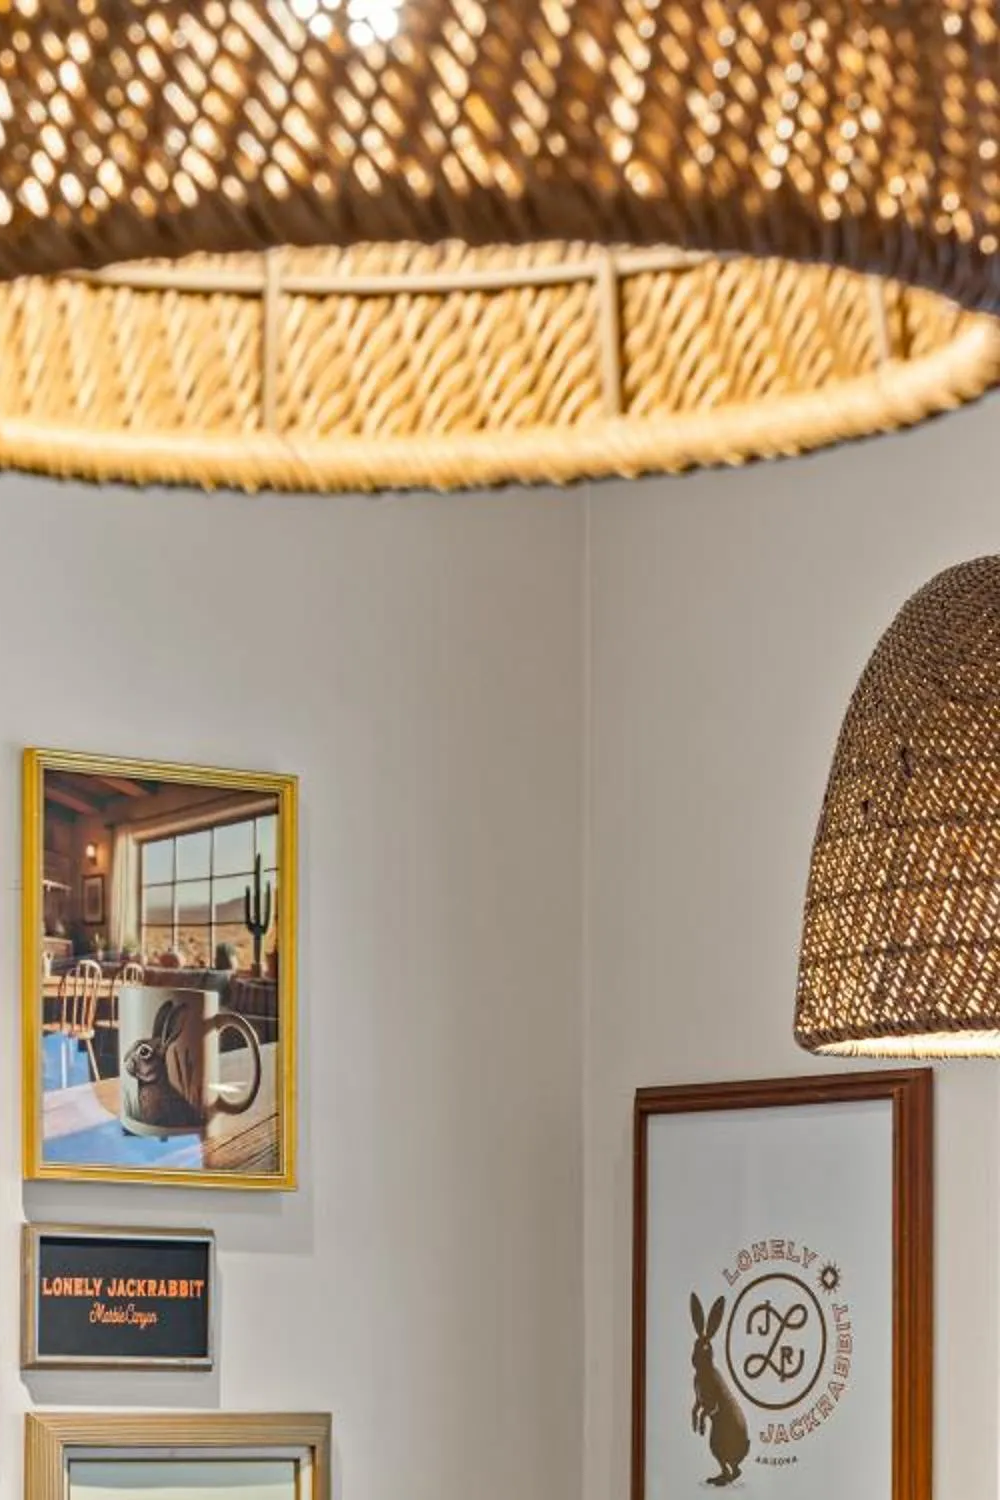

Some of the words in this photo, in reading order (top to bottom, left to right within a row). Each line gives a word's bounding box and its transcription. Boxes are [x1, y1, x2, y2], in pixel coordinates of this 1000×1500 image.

[722, 1239, 818, 1287] LONELY
[42, 1277, 103, 1296] LONELY
[107, 1279, 205, 1298] JACKRABBIT
